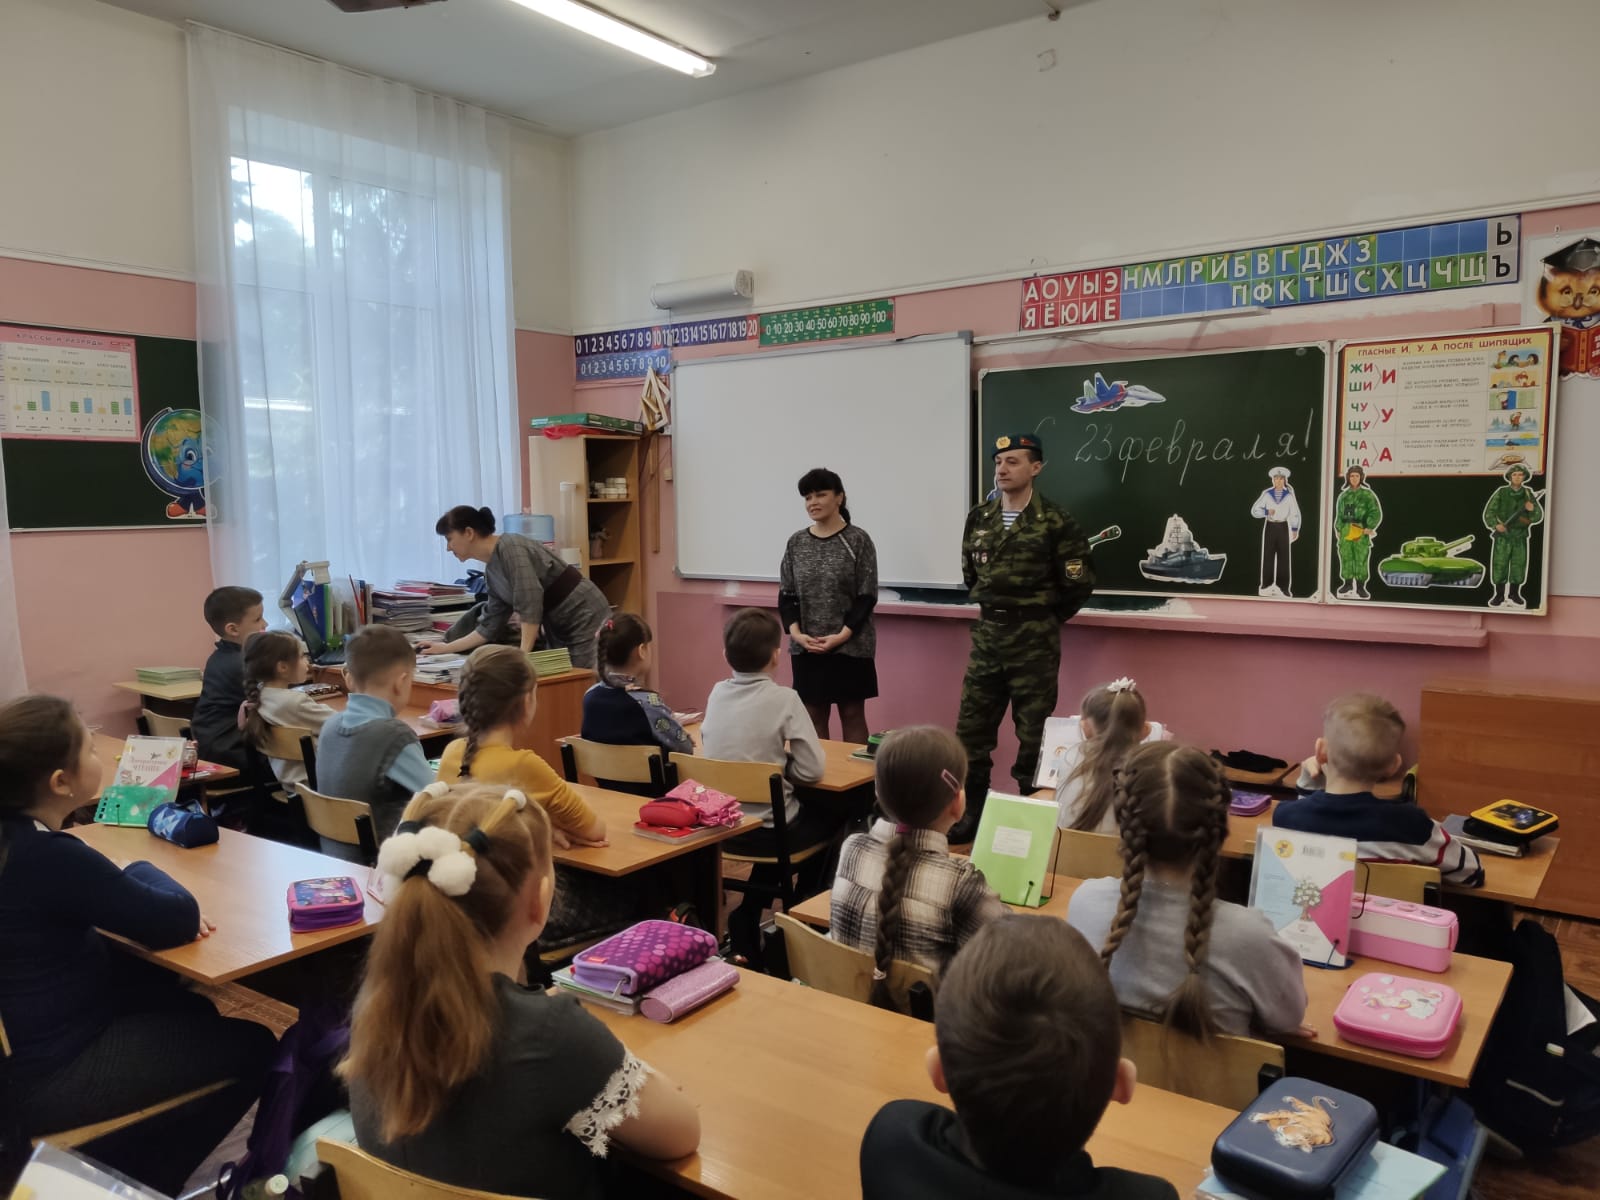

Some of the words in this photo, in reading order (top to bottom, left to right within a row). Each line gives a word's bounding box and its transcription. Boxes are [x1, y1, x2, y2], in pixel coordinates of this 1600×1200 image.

[1497, 222, 1512, 246] Ь
[1025, 282, 1038, 302] А
[1043, 279, 1058, 299] О
[1064, 276, 1077, 296] У
[1083, 274, 1099, 294] Ы
[1105, 272, 1118, 292] Э
[1124, 269, 1138, 290] Н
[1142, 267, 1161, 288] М
[1165, 263, 1180, 285] Л
[1191, 261, 1202, 282] Р
[1211, 256, 1227, 280] Й
[1234, 256, 1246, 277] Б
[1257, 253, 1270, 274] В
[1282, 250, 1294, 271] Г
[1302, 246, 1321, 272] Д
[1326, 243, 1348, 266] Ж
[1356, 240, 1370, 262] З
[1492, 255, 1511, 278] Ъ
[1024, 308, 1036, 328] Я
[1044, 303, 1054, 325] Ё
[1061, 303, 1078, 324] Ю
[1082, 301, 1097, 322] И
[1104, 299, 1116, 319] Е
[1253, 282, 1272, 302] Ф
[1279, 279, 1294, 301] К
[1305, 276, 1319, 297] Т
[1326, 274, 1348, 296] Ш
[1354, 270, 1370, 292] С
[1381, 268, 1397, 290] Х
[1407, 264, 1426, 288] Ц
[1436, 262, 1451, 282] Ч
[1460, 257, 1485, 282] Щ
[766, 325, 771, 335] 0
[773, 323, 782, 334] 10
[784, 322, 793, 333] 20
[795, 321, 804, 332] 30
[806, 319, 815, 330] 40
[817, 318, 826, 330] 50
[828, 316, 837, 328] 60
[839, 315, 848, 326] 70
[849, 314, 859, 326] 80
[860, 312, 870, 324] 90
[872, 310, 886, 323] 100
[576, 339, 582, 354] 0
[584, 338, 588, 352] 1
[592, 337, 597, 352] 2
[599, 336, 604, 351] 3
[606, 335, 612, 350] 4
[614, 334, 619, 350] 5
[621, 333, 627, 349] 6
[629, 332, 635, 348] 7
[637, 331, 644, 348] 8
[645, 331, 652, 347] 9
[653, 329, 662, 346] 10
[680, 326, 689, 343] 13
[689, 325, 699, 342] 14
[698, 324, 708, 341] 15
[708, 323, 718, 340] 16
[718, 322, 727, 339] 17
[728, 321, 738, 338] 18
[738, 320, 747, 337] 19
[747, 319, 758, 336] 20
[1358, 347, 1396, 357] ГЛАСНЫЕ
[1430, 343, 1438, 351] А
[1443, 341, 1473, 350] ПОСЛЕ
[1479, 336, 1532, 349] ШИПЯЩИХ
[1350, 362, 1373, 373] ЖИ
[1382, 369, 1396, 384] И
[1349, 380, 1372, 392] ШИ
[1351, 402, 1368, 412] ЧУ
[1381, 408, 1394, 423] У
[1348, 420, 1370, 432] ЩУ
[1074, 423, 1113, 462] 23
[1350, 440, 1368, 450] ЧА
[1379, 447, 1392, 462] А
